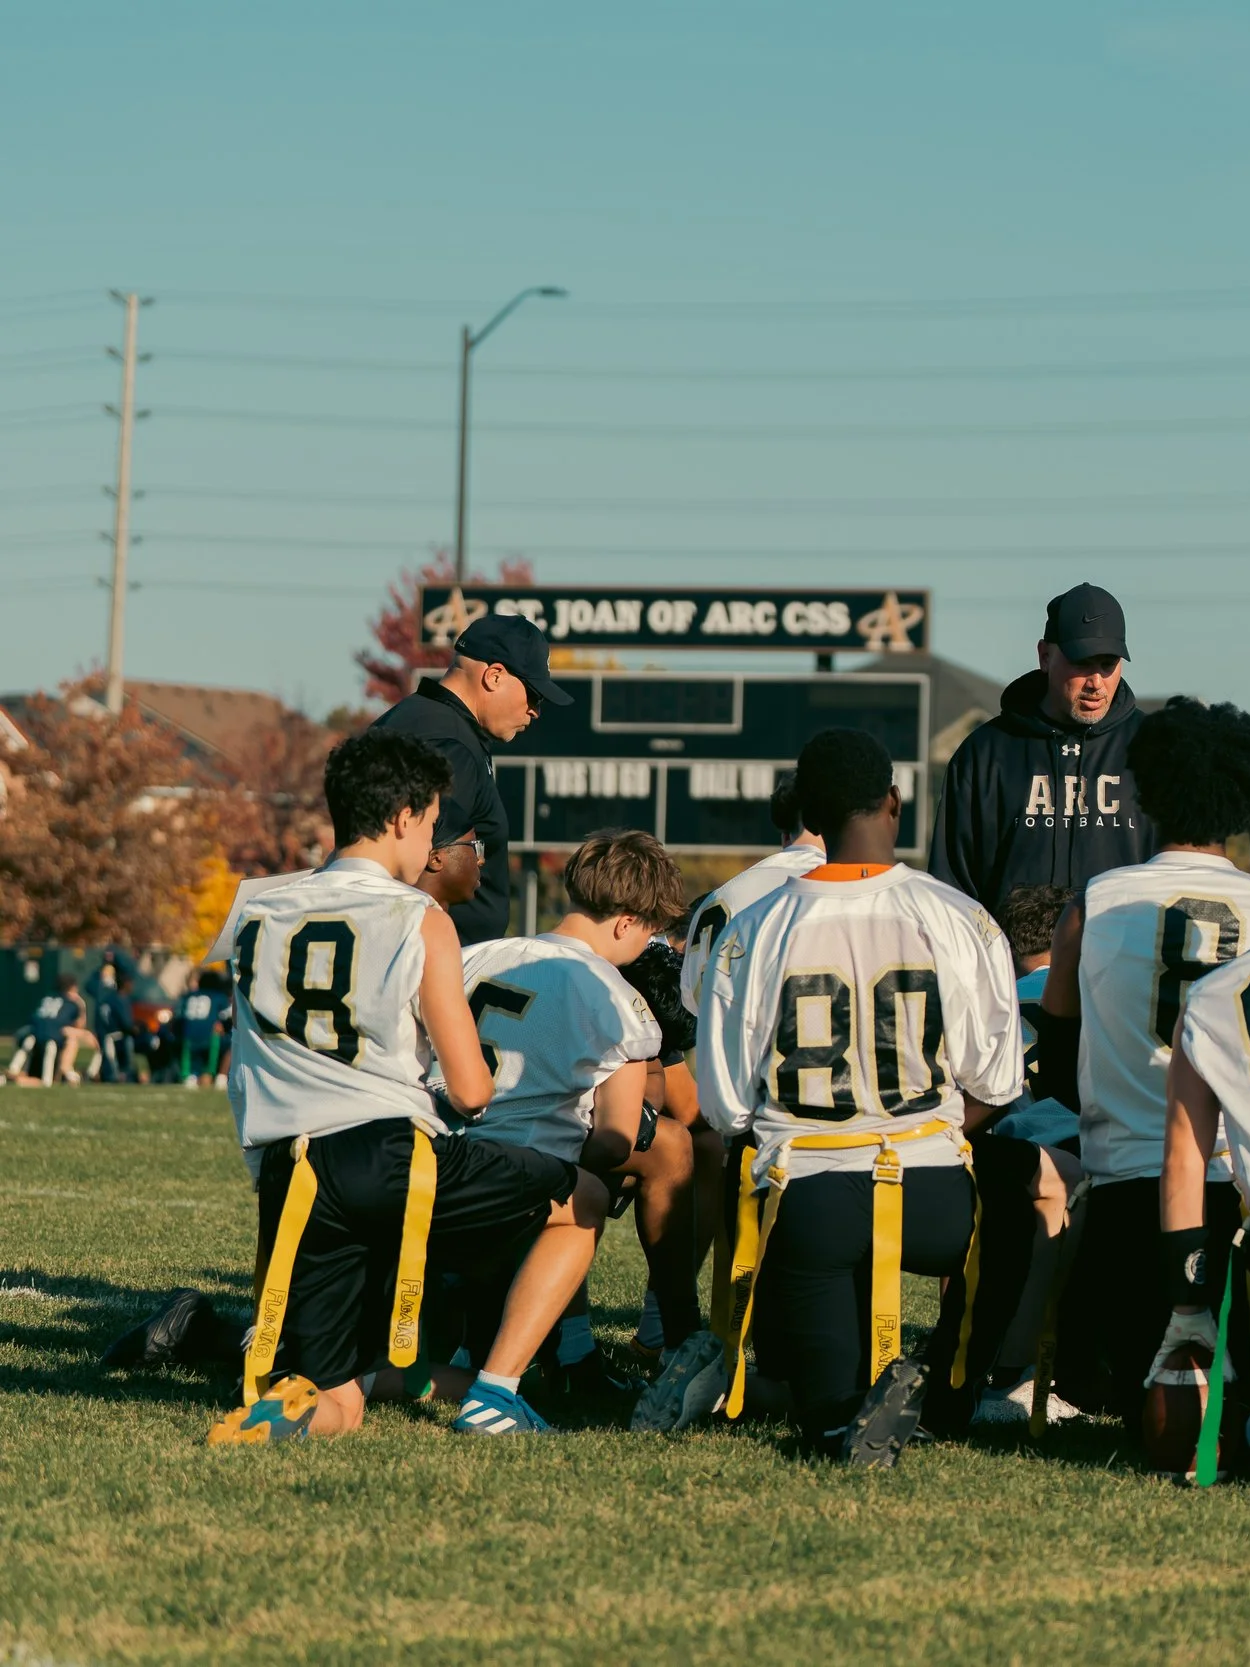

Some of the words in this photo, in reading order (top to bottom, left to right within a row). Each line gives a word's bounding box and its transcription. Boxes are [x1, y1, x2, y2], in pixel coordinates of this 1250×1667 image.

[551, 599, 643, 640] JOAN
[647, 600, 697, 634] OF
[700, 601, 777, 636] ARC
[782, 601, 851, 636] CSS
[1026, 774, 1120, 815] ARC
[233, 913, 366, 1070] 18
[768, 962, 956, 1125] 80
[875, 1314, 898, 1381] FLAGAT
